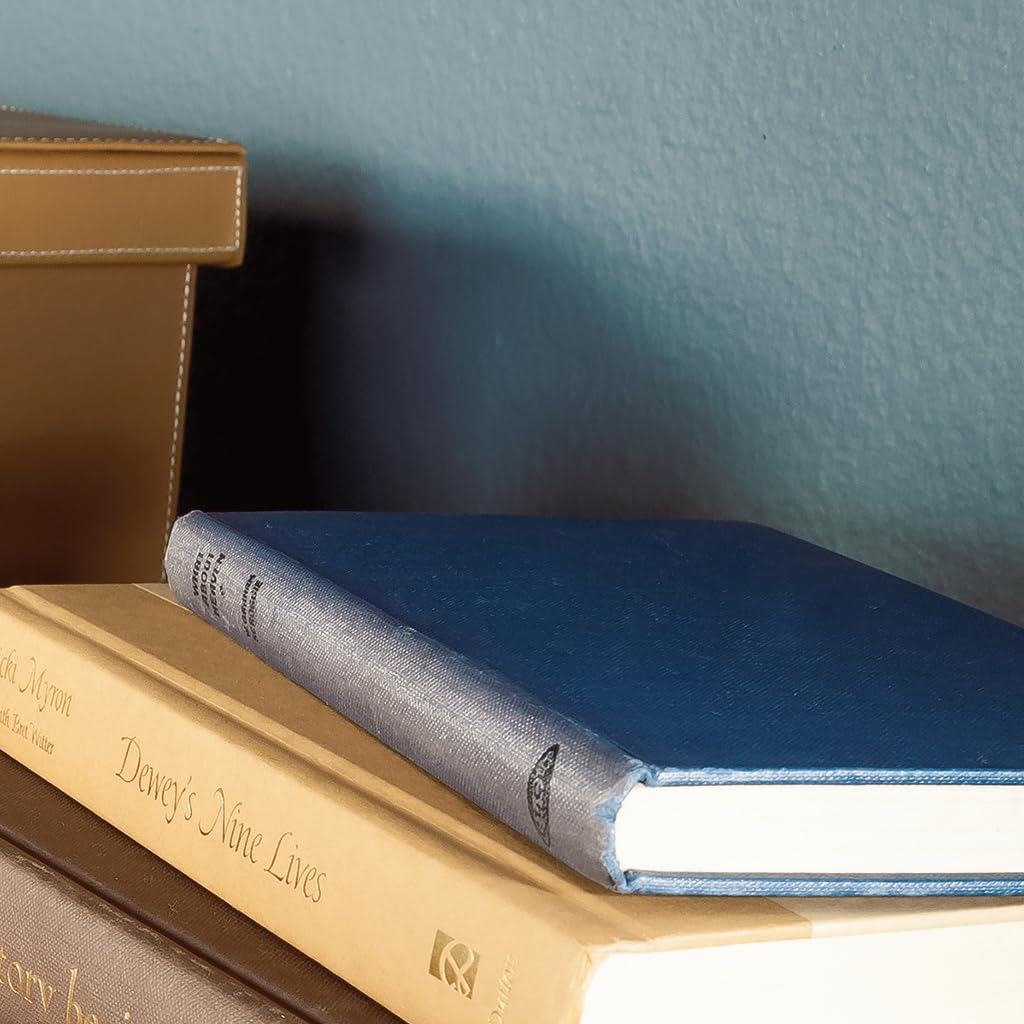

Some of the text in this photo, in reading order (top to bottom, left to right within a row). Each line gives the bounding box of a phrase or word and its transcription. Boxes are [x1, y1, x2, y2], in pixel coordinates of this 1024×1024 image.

[191, 551, 204, 597] WHAT
[200, 552, 215, 607] ABOUT
[18, 656, 74, 719] Myron
[11, 712, 29, 740] Bret
[29, 721, 55, 755] Witter
[114, 735, 328, 904] Dewey's Nine Lives
